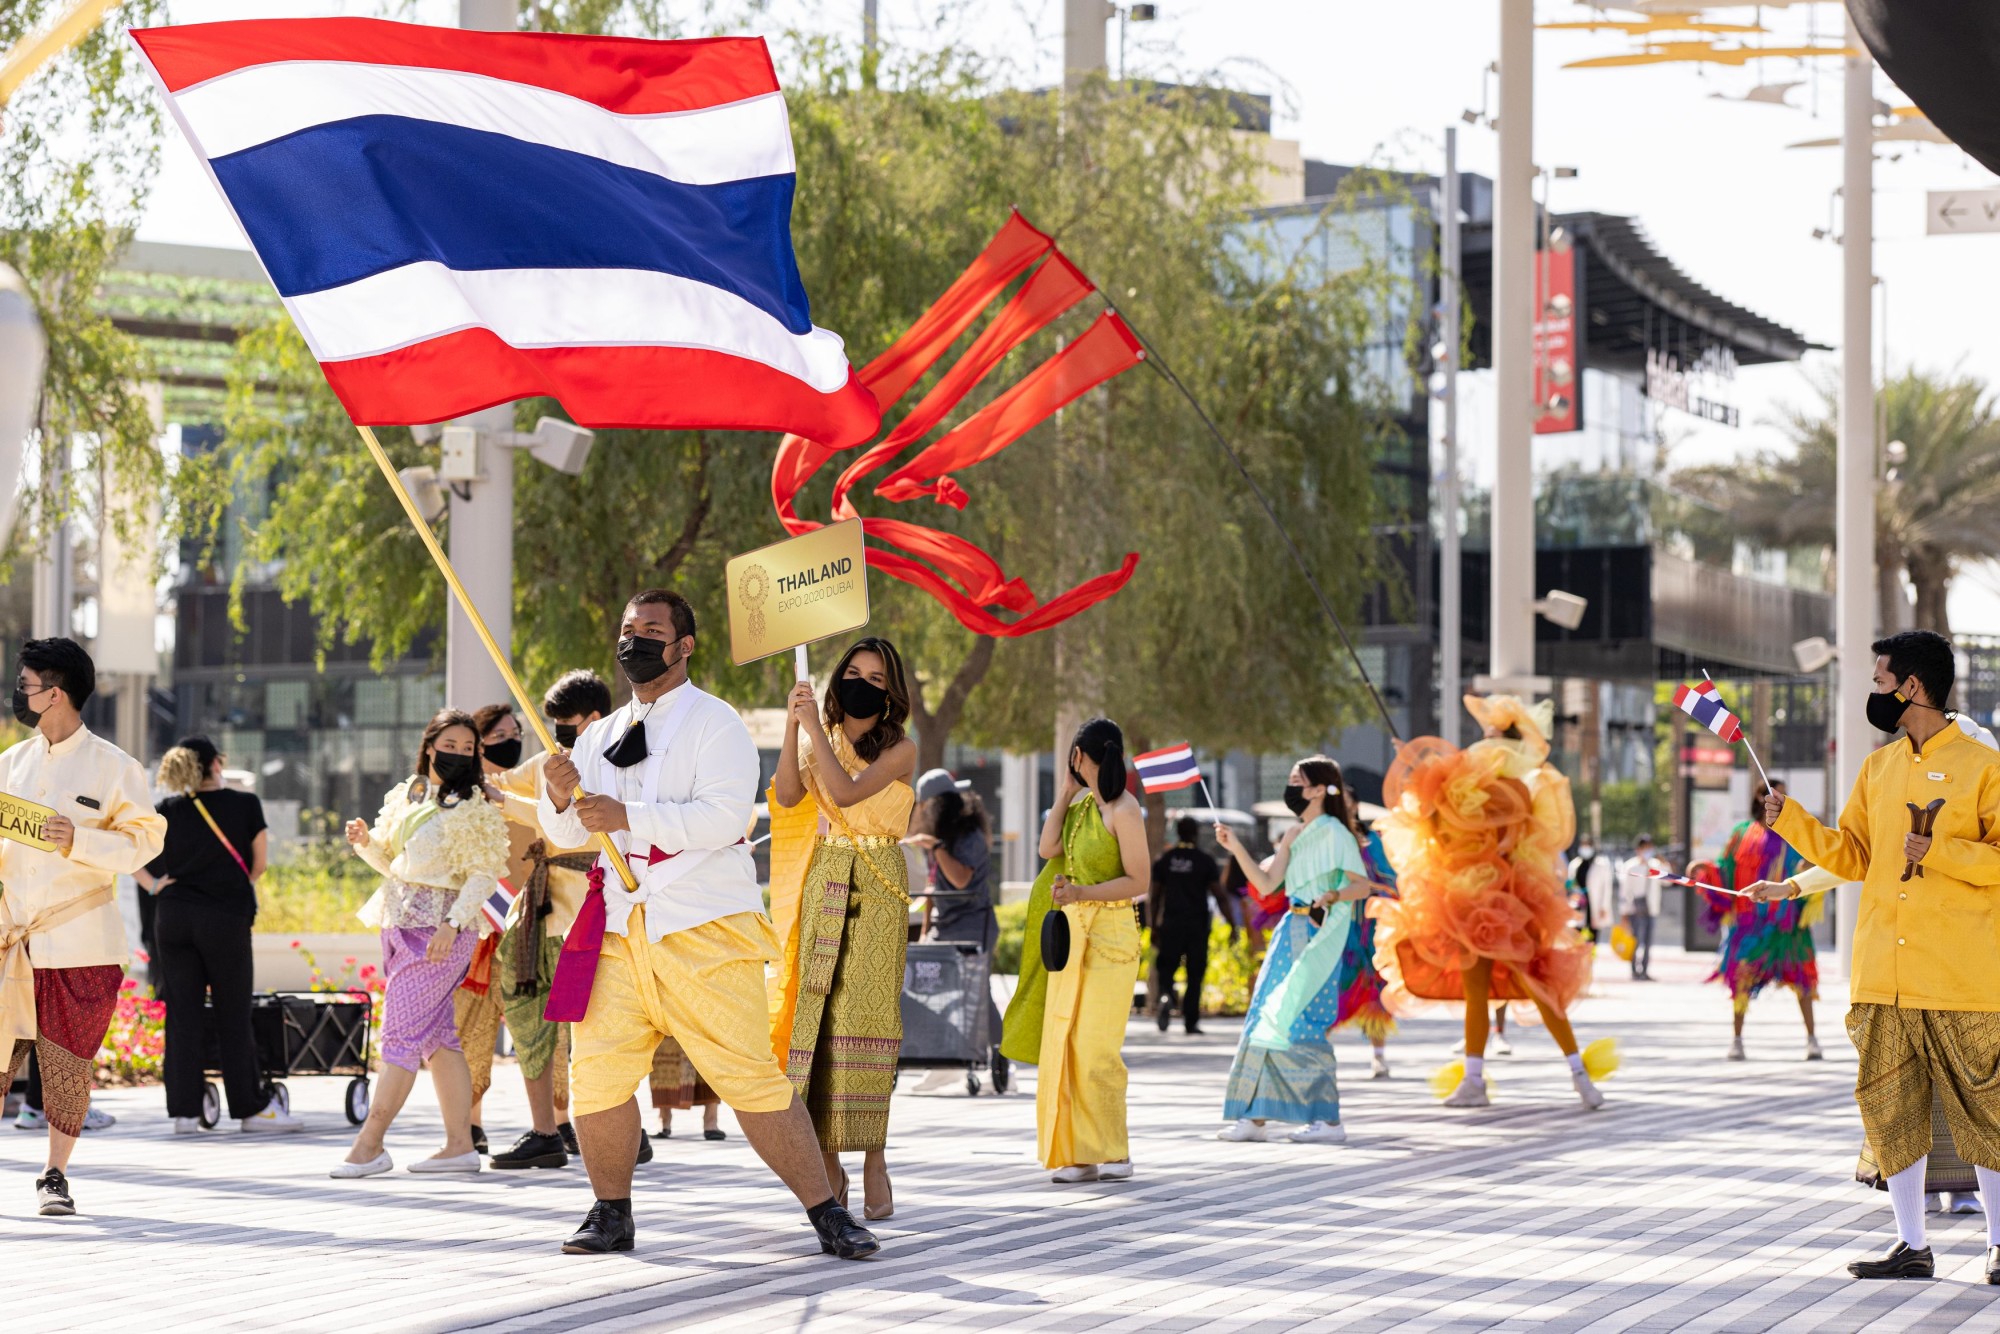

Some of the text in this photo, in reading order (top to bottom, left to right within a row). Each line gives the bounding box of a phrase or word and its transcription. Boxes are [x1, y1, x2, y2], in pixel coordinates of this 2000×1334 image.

[777, 557, 852, 594] THAILAND
[778, 579, 854, 613] EXPO 2020 DUBAI
[17, 806, 49, 824] DUBA
